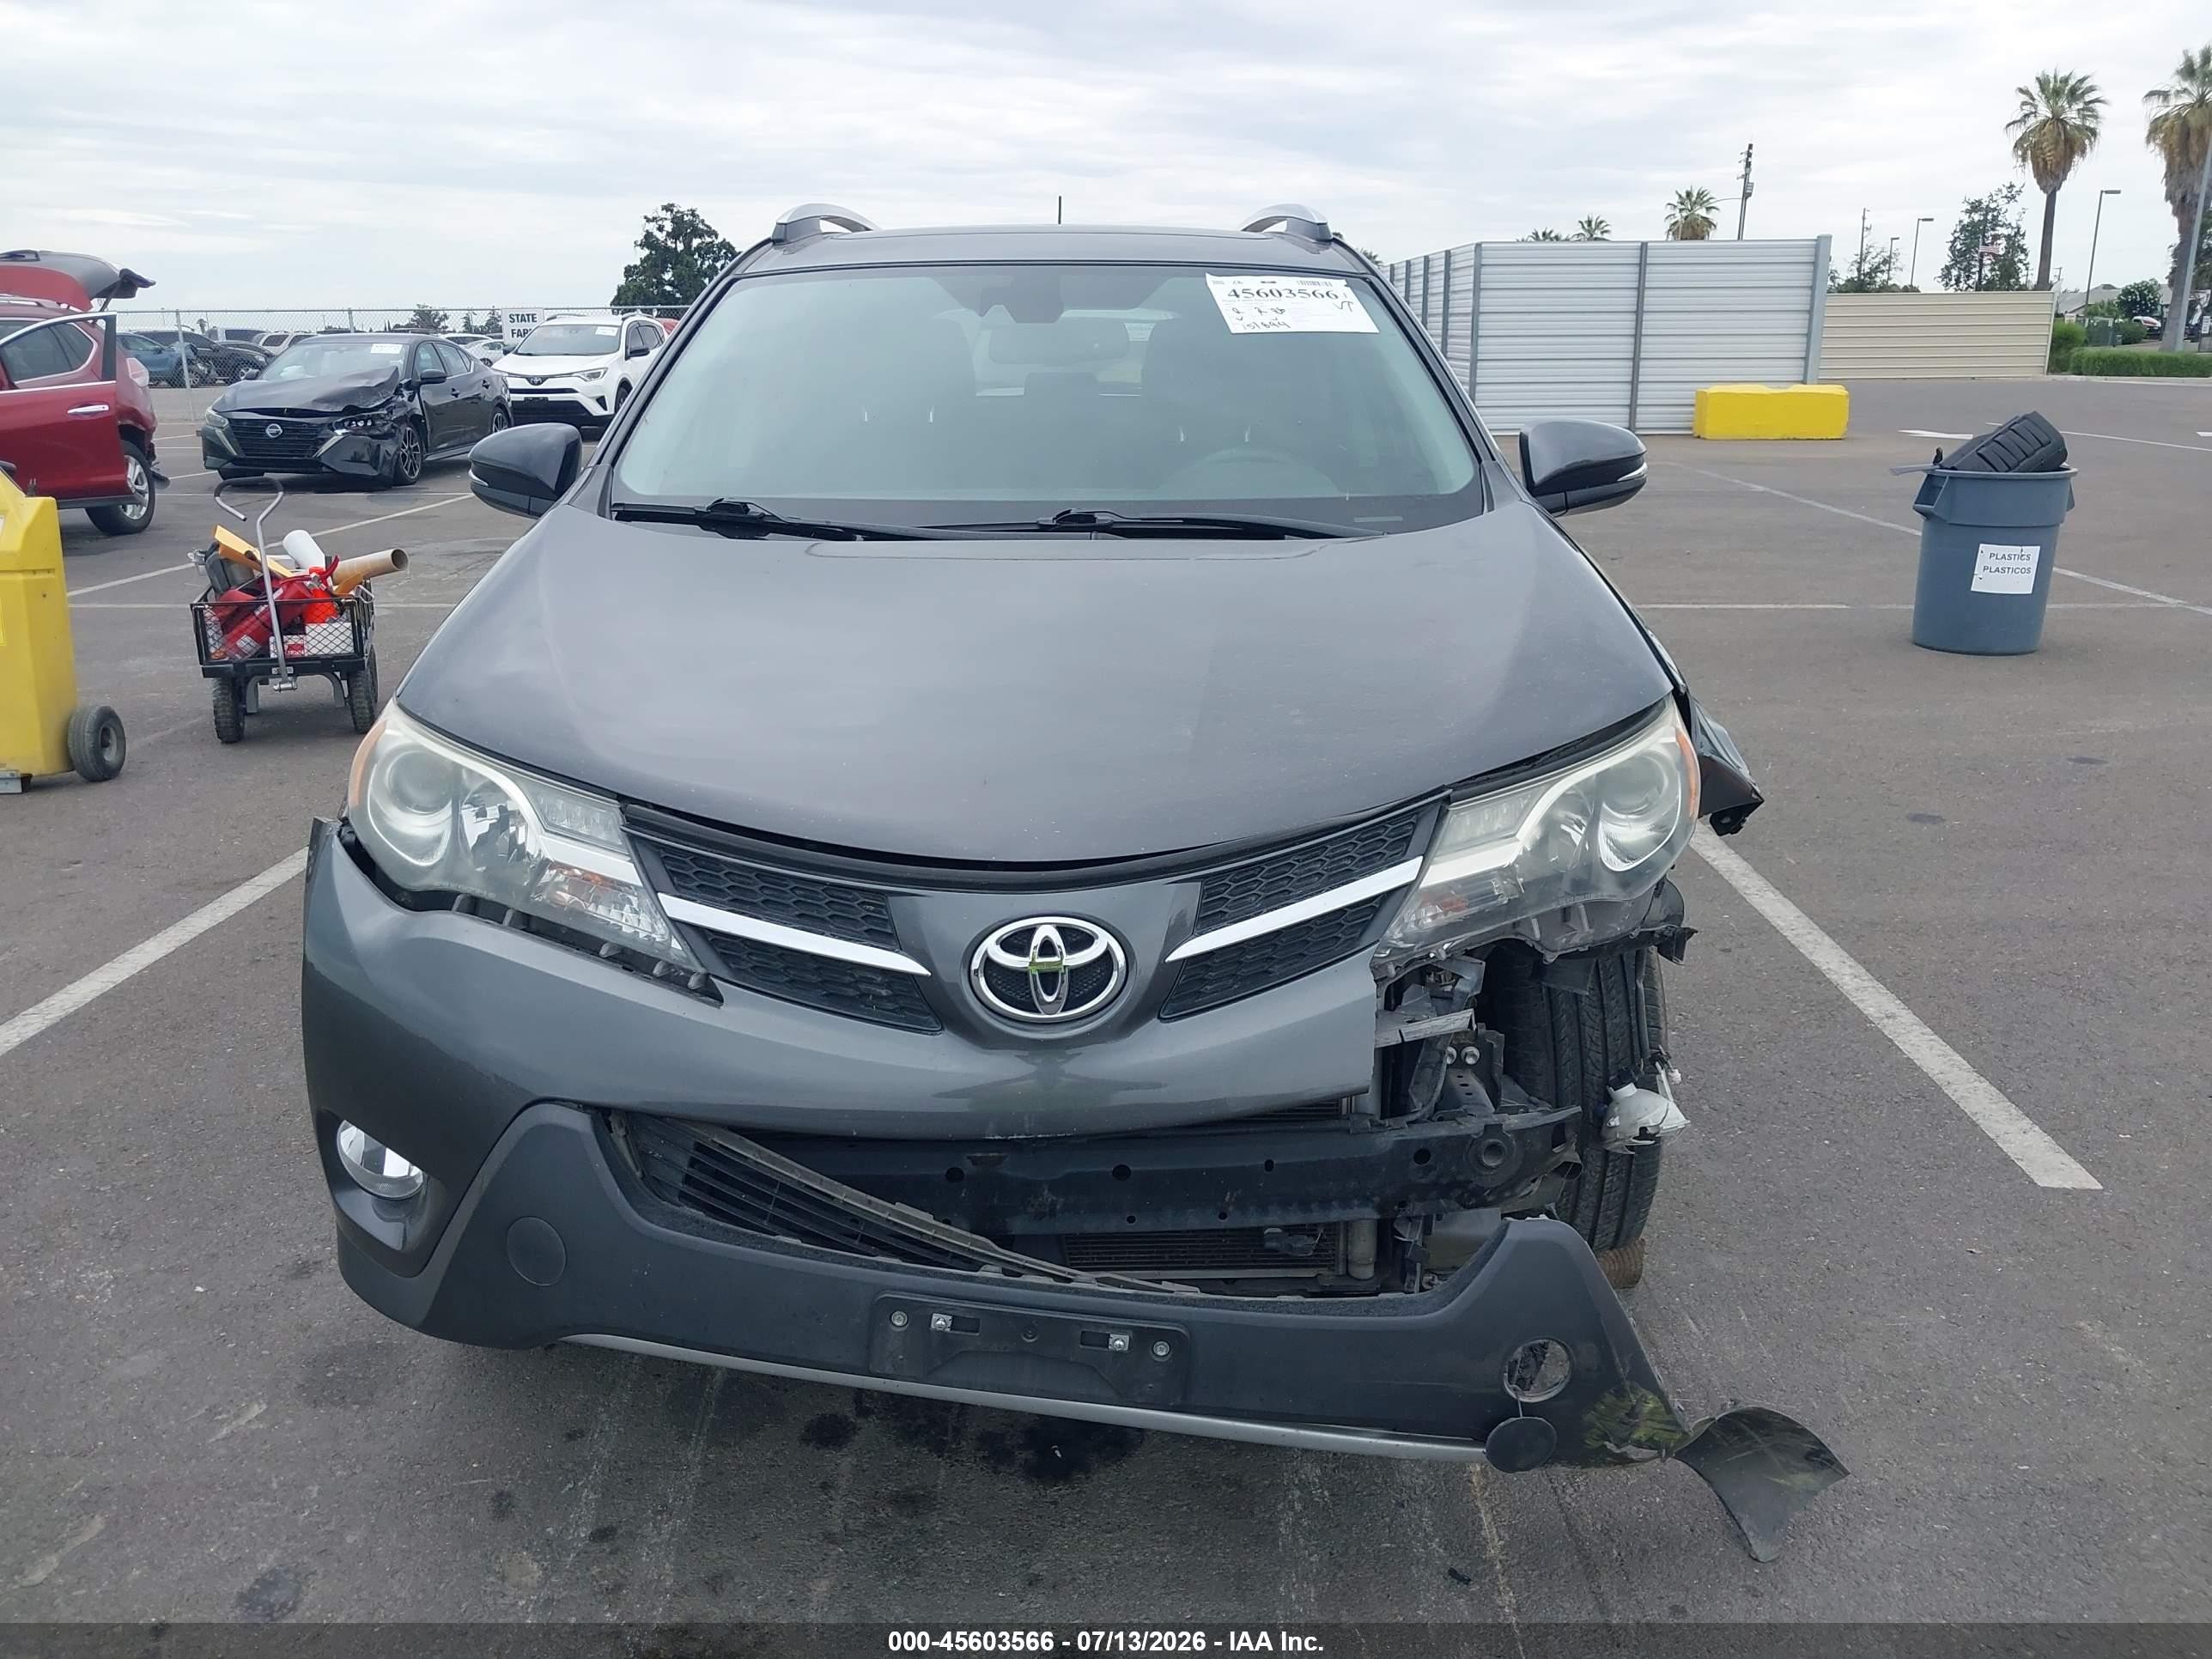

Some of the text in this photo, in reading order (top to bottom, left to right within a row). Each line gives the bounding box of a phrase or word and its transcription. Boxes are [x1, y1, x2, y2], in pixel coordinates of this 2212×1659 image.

[1227, 288, 1339, 300] 45603566
[508, 313, 538, 323] STATE
[1989, 552, 2032, 562] PLASTICS
[1983, 565, 2032, 574] PLASTICOS
